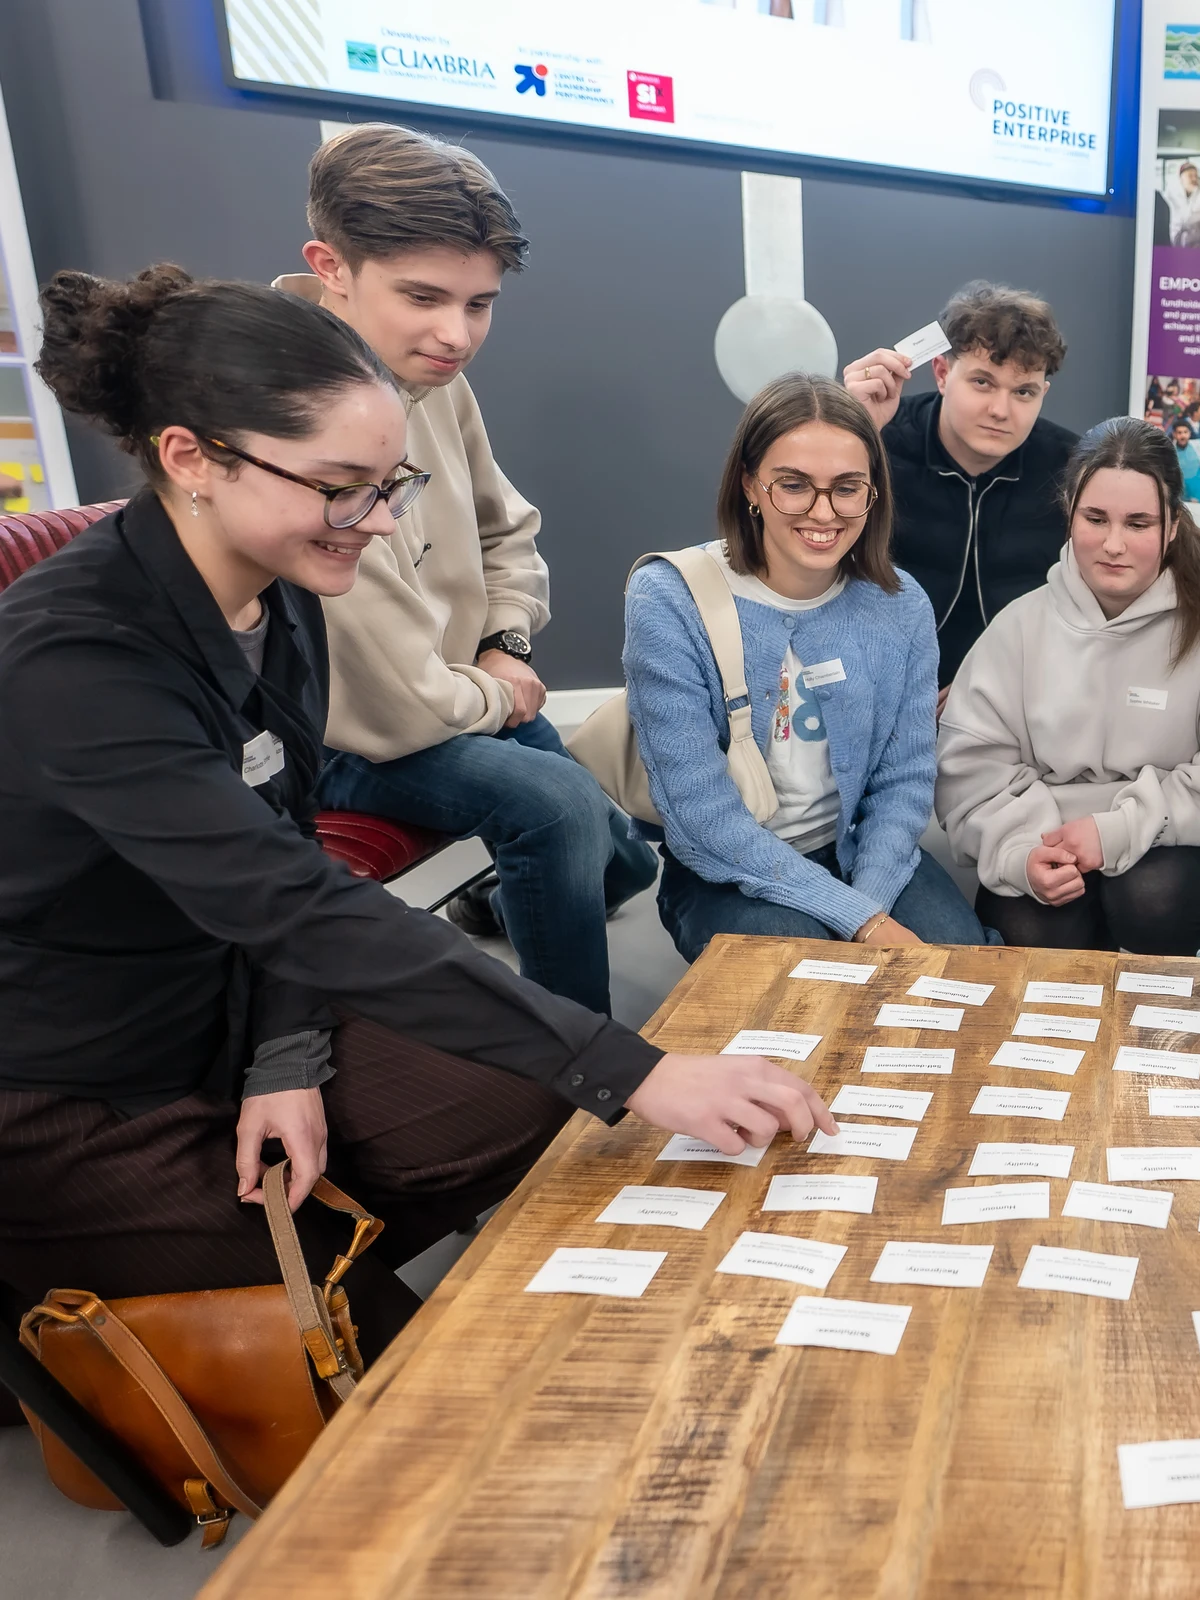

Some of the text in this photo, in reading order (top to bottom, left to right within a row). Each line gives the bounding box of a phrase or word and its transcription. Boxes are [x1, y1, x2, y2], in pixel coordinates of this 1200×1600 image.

[381, 45, 496, 80] CUMBRIA
[994, 99, 1070, 126] POSITIVE
[993, 119, 1098, 149] ENTERPRISE
